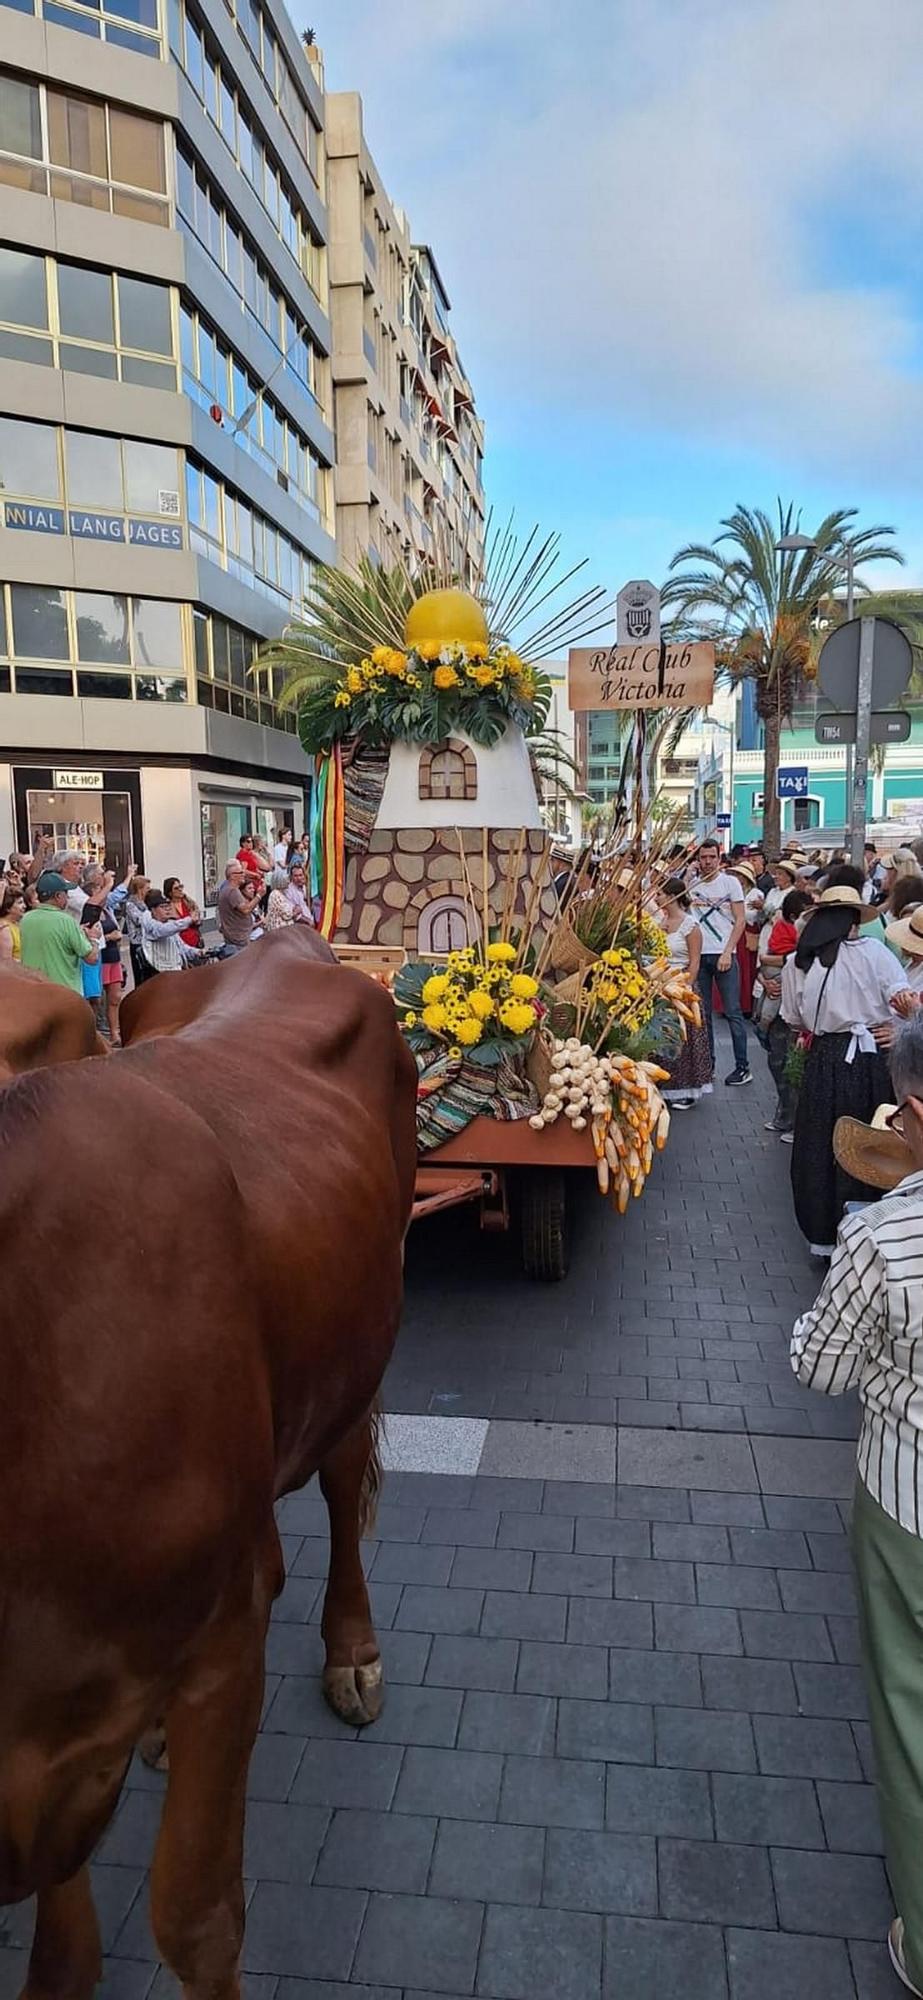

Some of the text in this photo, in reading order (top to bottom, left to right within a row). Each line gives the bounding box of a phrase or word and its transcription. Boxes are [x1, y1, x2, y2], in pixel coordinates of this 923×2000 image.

[71, 515, 180, 545] LANGUAGES
[590, 643, 693, 676] Real Cub
[60, 775, 100, 785] ALE-HOP
[779, 776, 807, 789] TAXI
